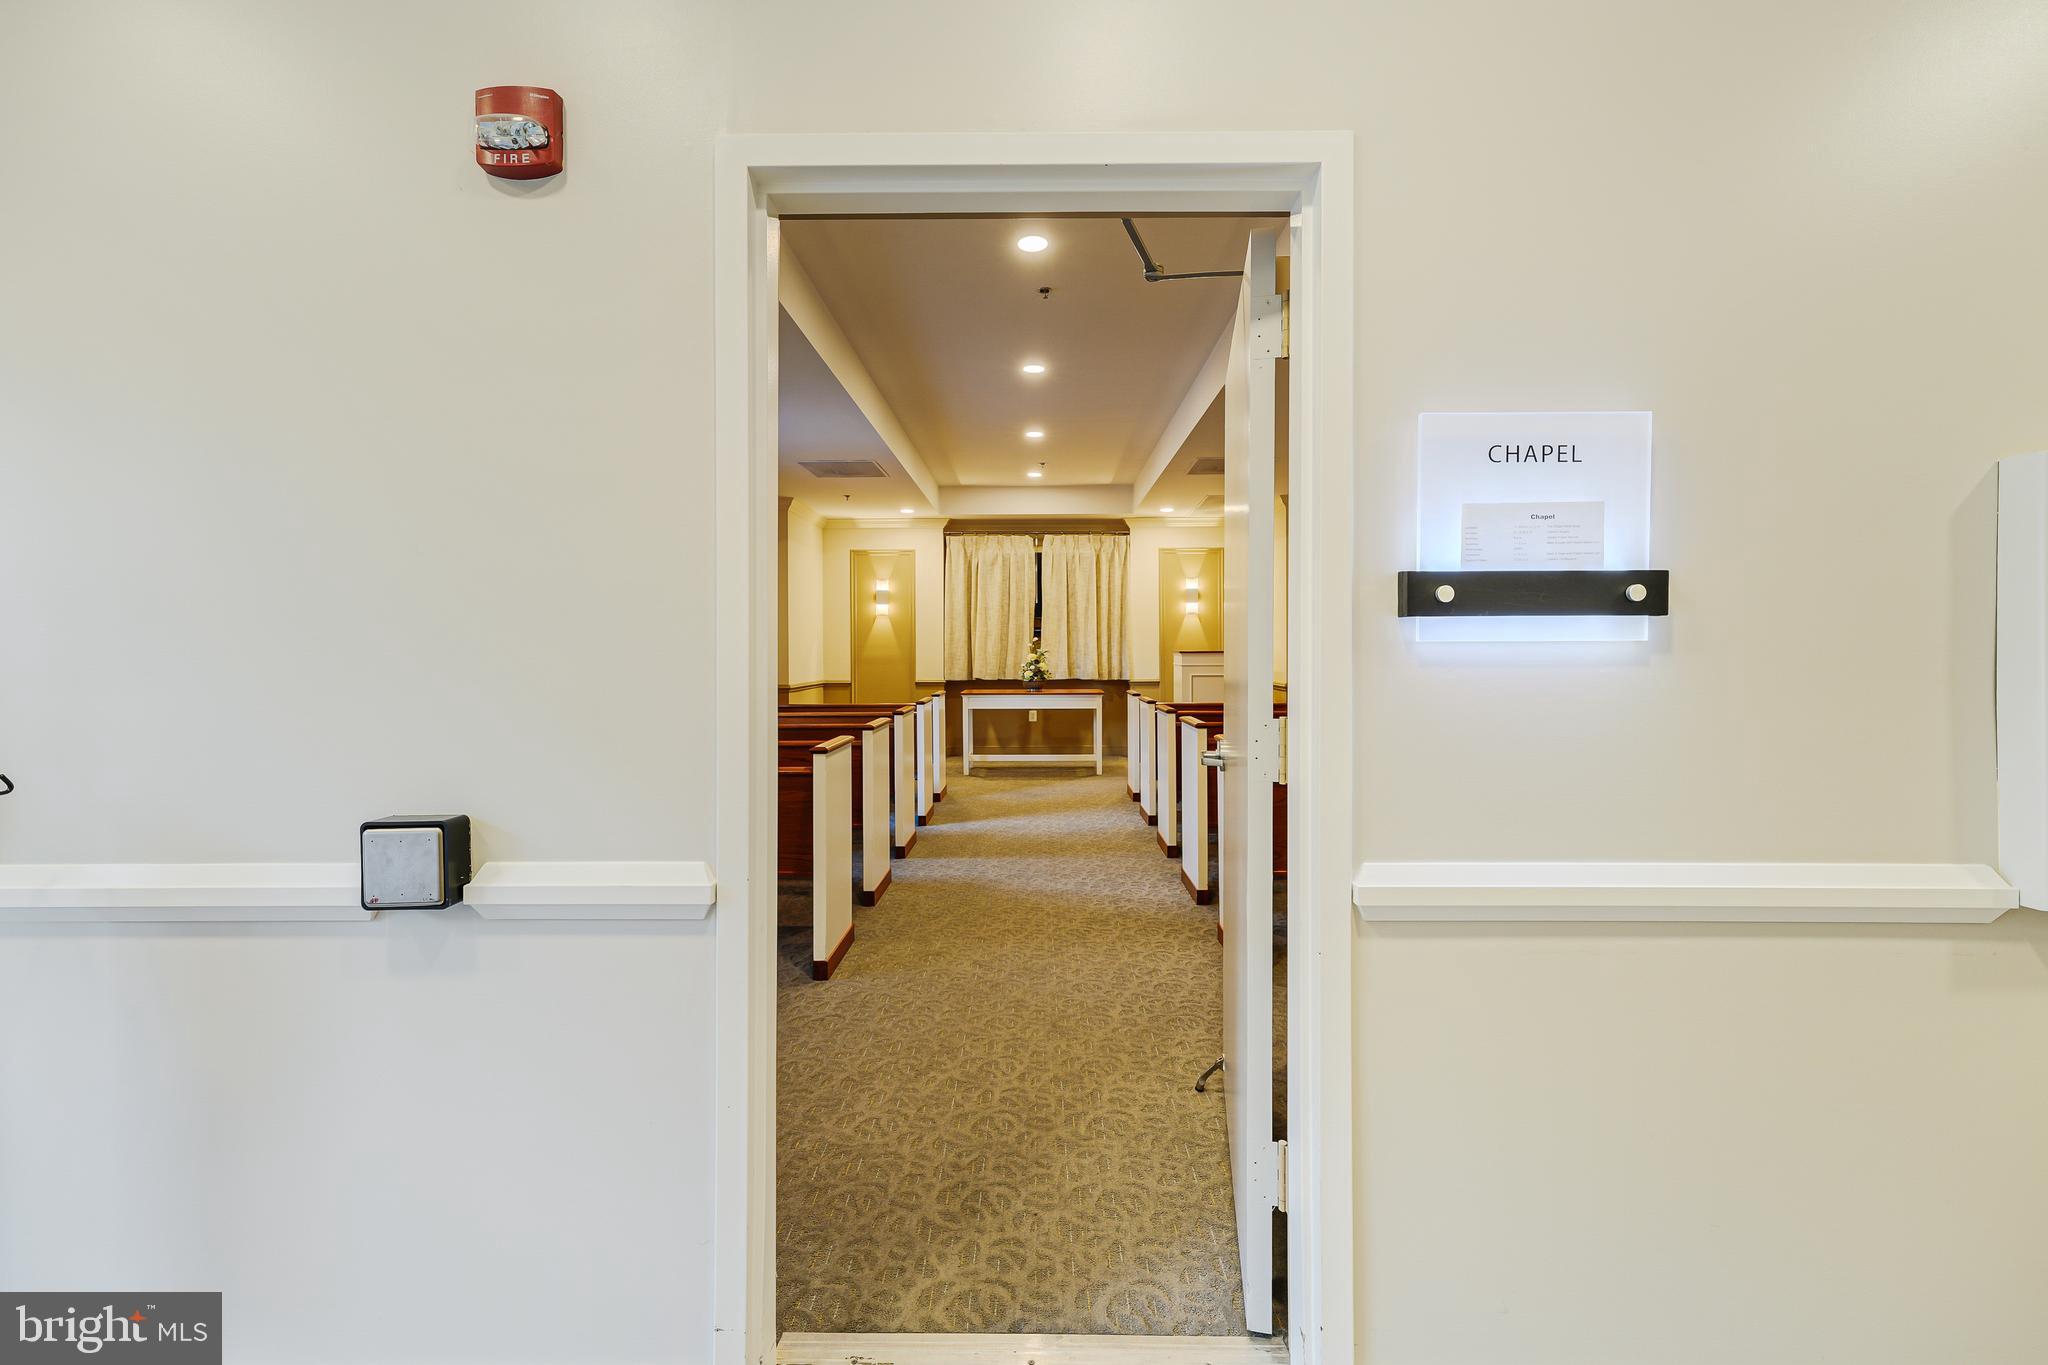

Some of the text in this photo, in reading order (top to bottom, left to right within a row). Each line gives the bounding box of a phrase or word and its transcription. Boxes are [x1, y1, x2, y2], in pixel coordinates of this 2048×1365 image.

[494, 153, 531, 164] FIRE
[1488, 444, 1583, 463] CHAPEL
[1530, 513, 1556, 521] Chapel
